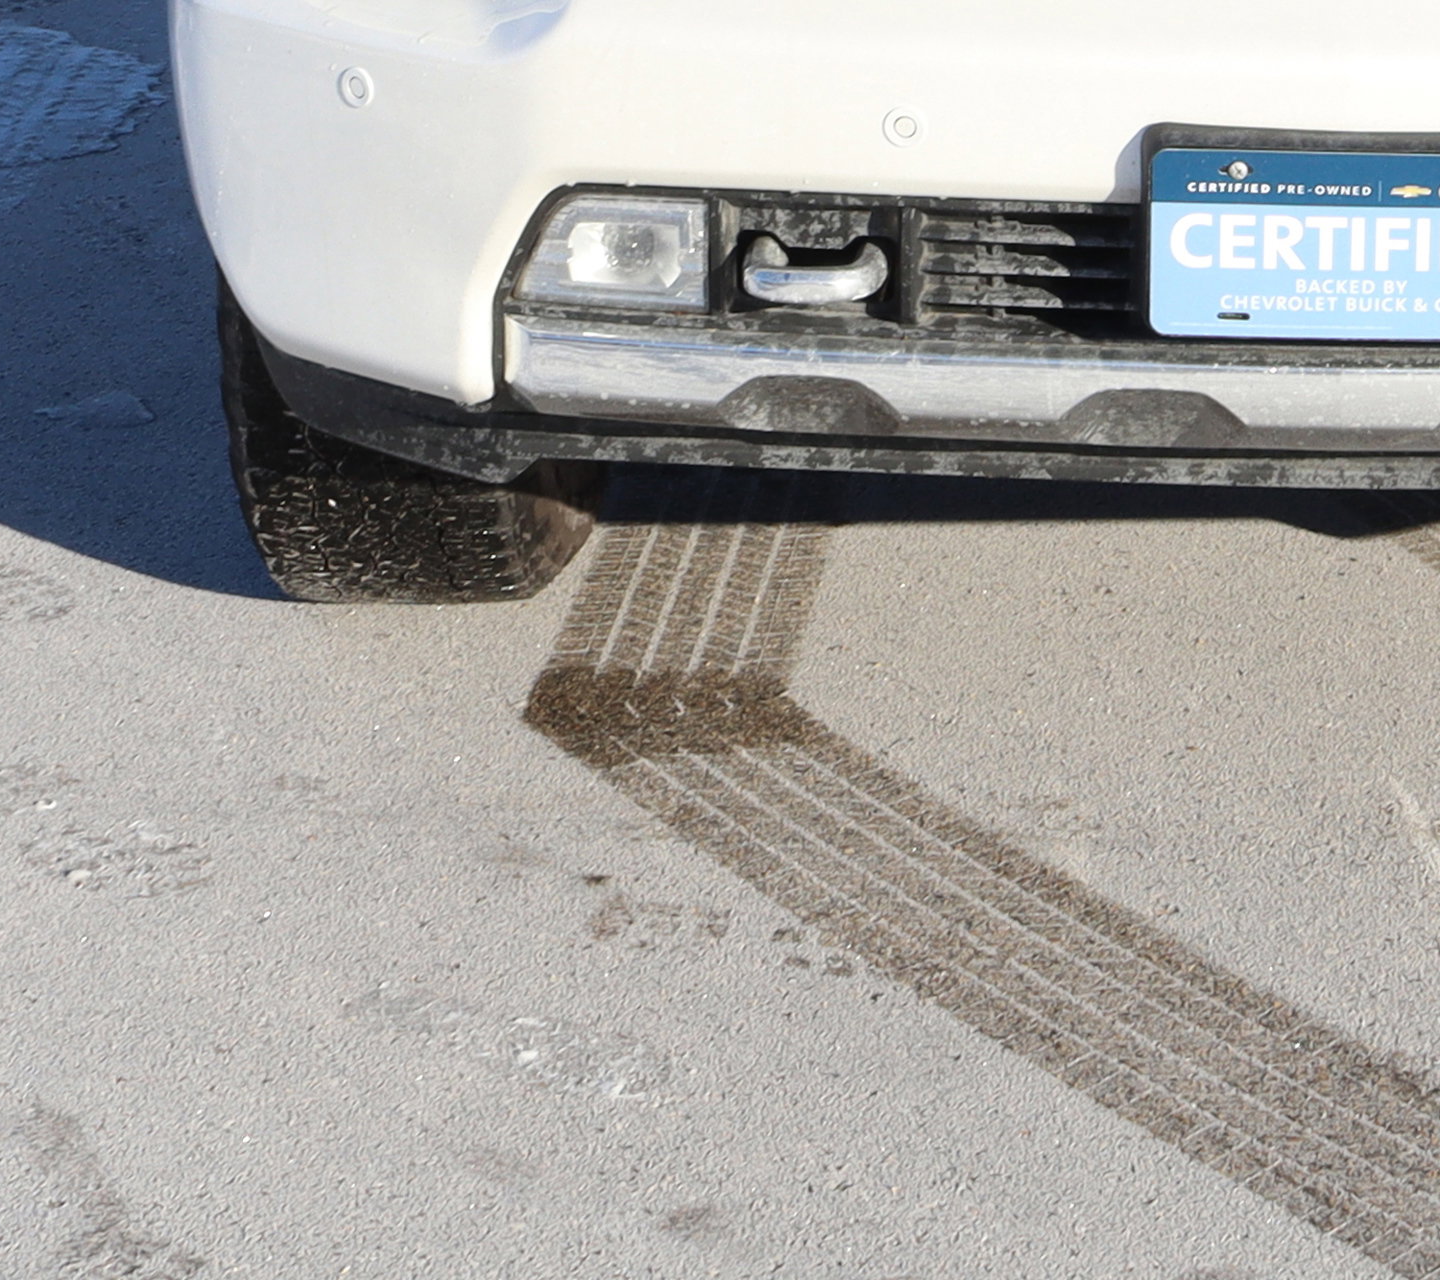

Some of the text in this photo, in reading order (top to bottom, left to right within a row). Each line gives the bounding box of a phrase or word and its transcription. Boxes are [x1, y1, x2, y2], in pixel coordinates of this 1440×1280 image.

[1187, 181, 1271, 195] CERTIFIED
[1277, 183, 1372, 197] PRE-OWNED
[1295, 278, 1408, 295] BACKED BY
[1220, 294, 1336, 312] CHEVROLET
[1345, 296, 1407, 312] BUICK
[1413, 298, 1428, 312] &
